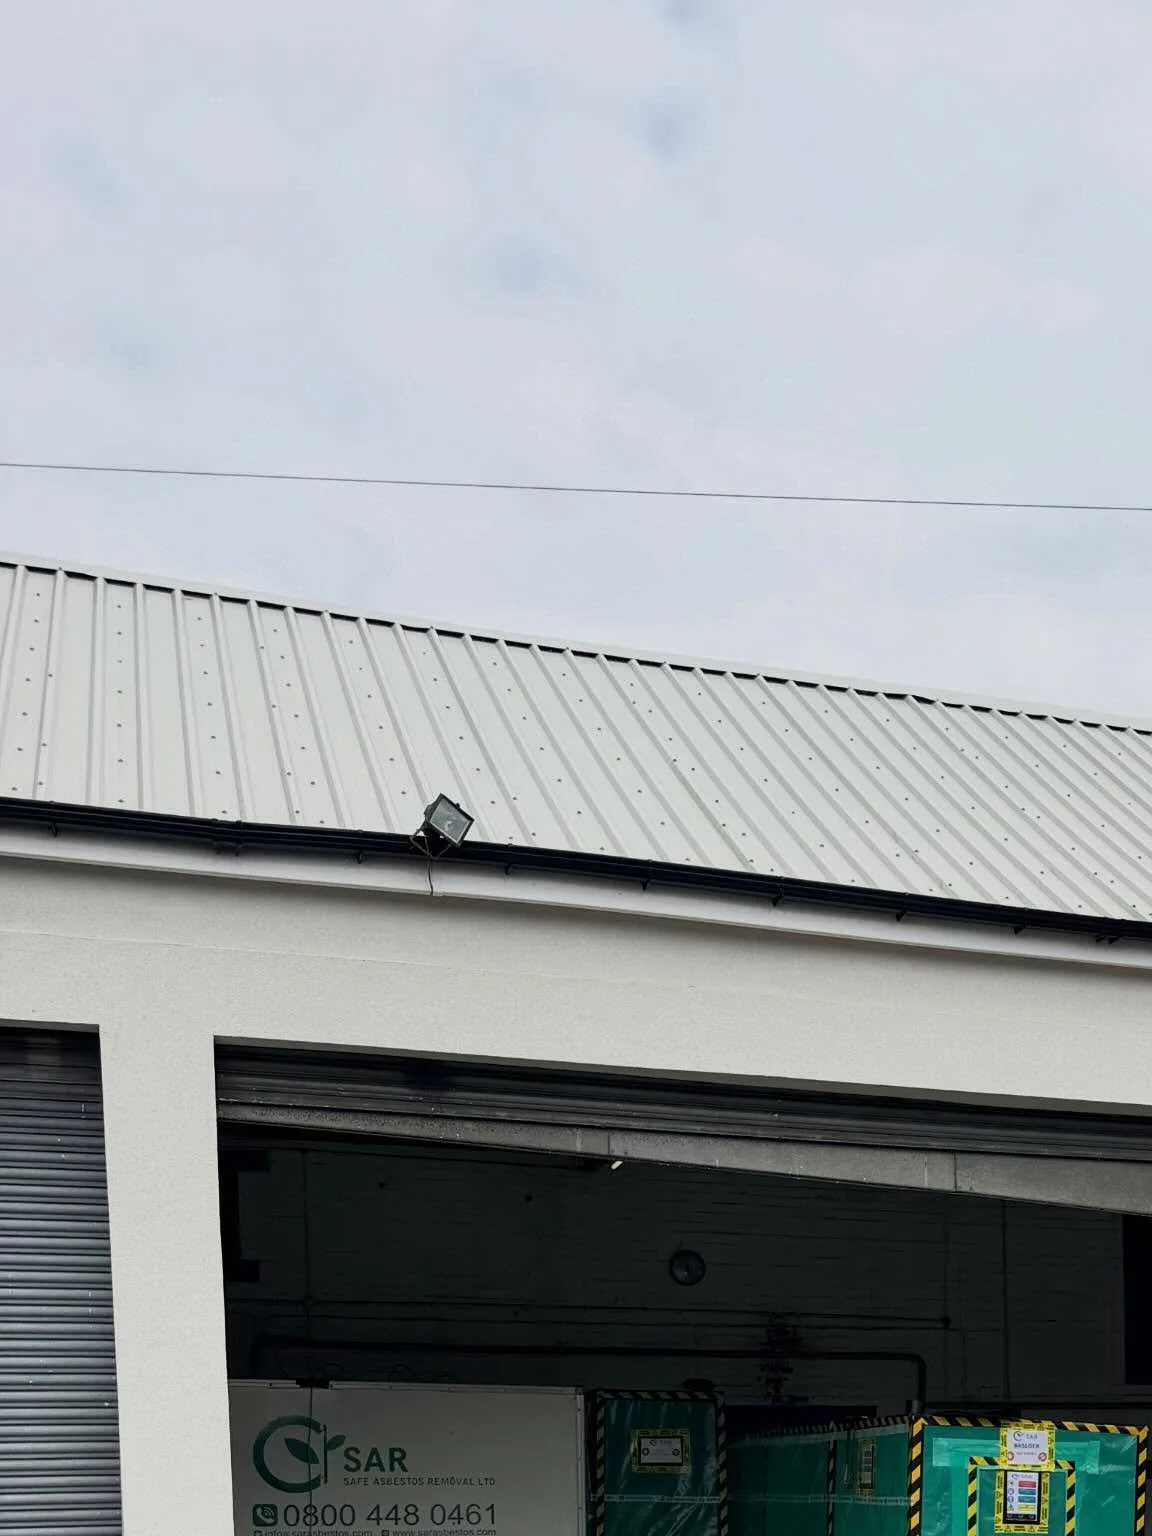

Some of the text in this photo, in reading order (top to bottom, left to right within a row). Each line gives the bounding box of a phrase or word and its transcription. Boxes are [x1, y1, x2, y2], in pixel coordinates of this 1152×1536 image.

[344, 1447, 409, 1473] SAR
[343, 1477, 496, 1487] SAFE ASBESTOS REMOVAL LTD
[284, 1503, 496, 1527] 0800 448 0461
